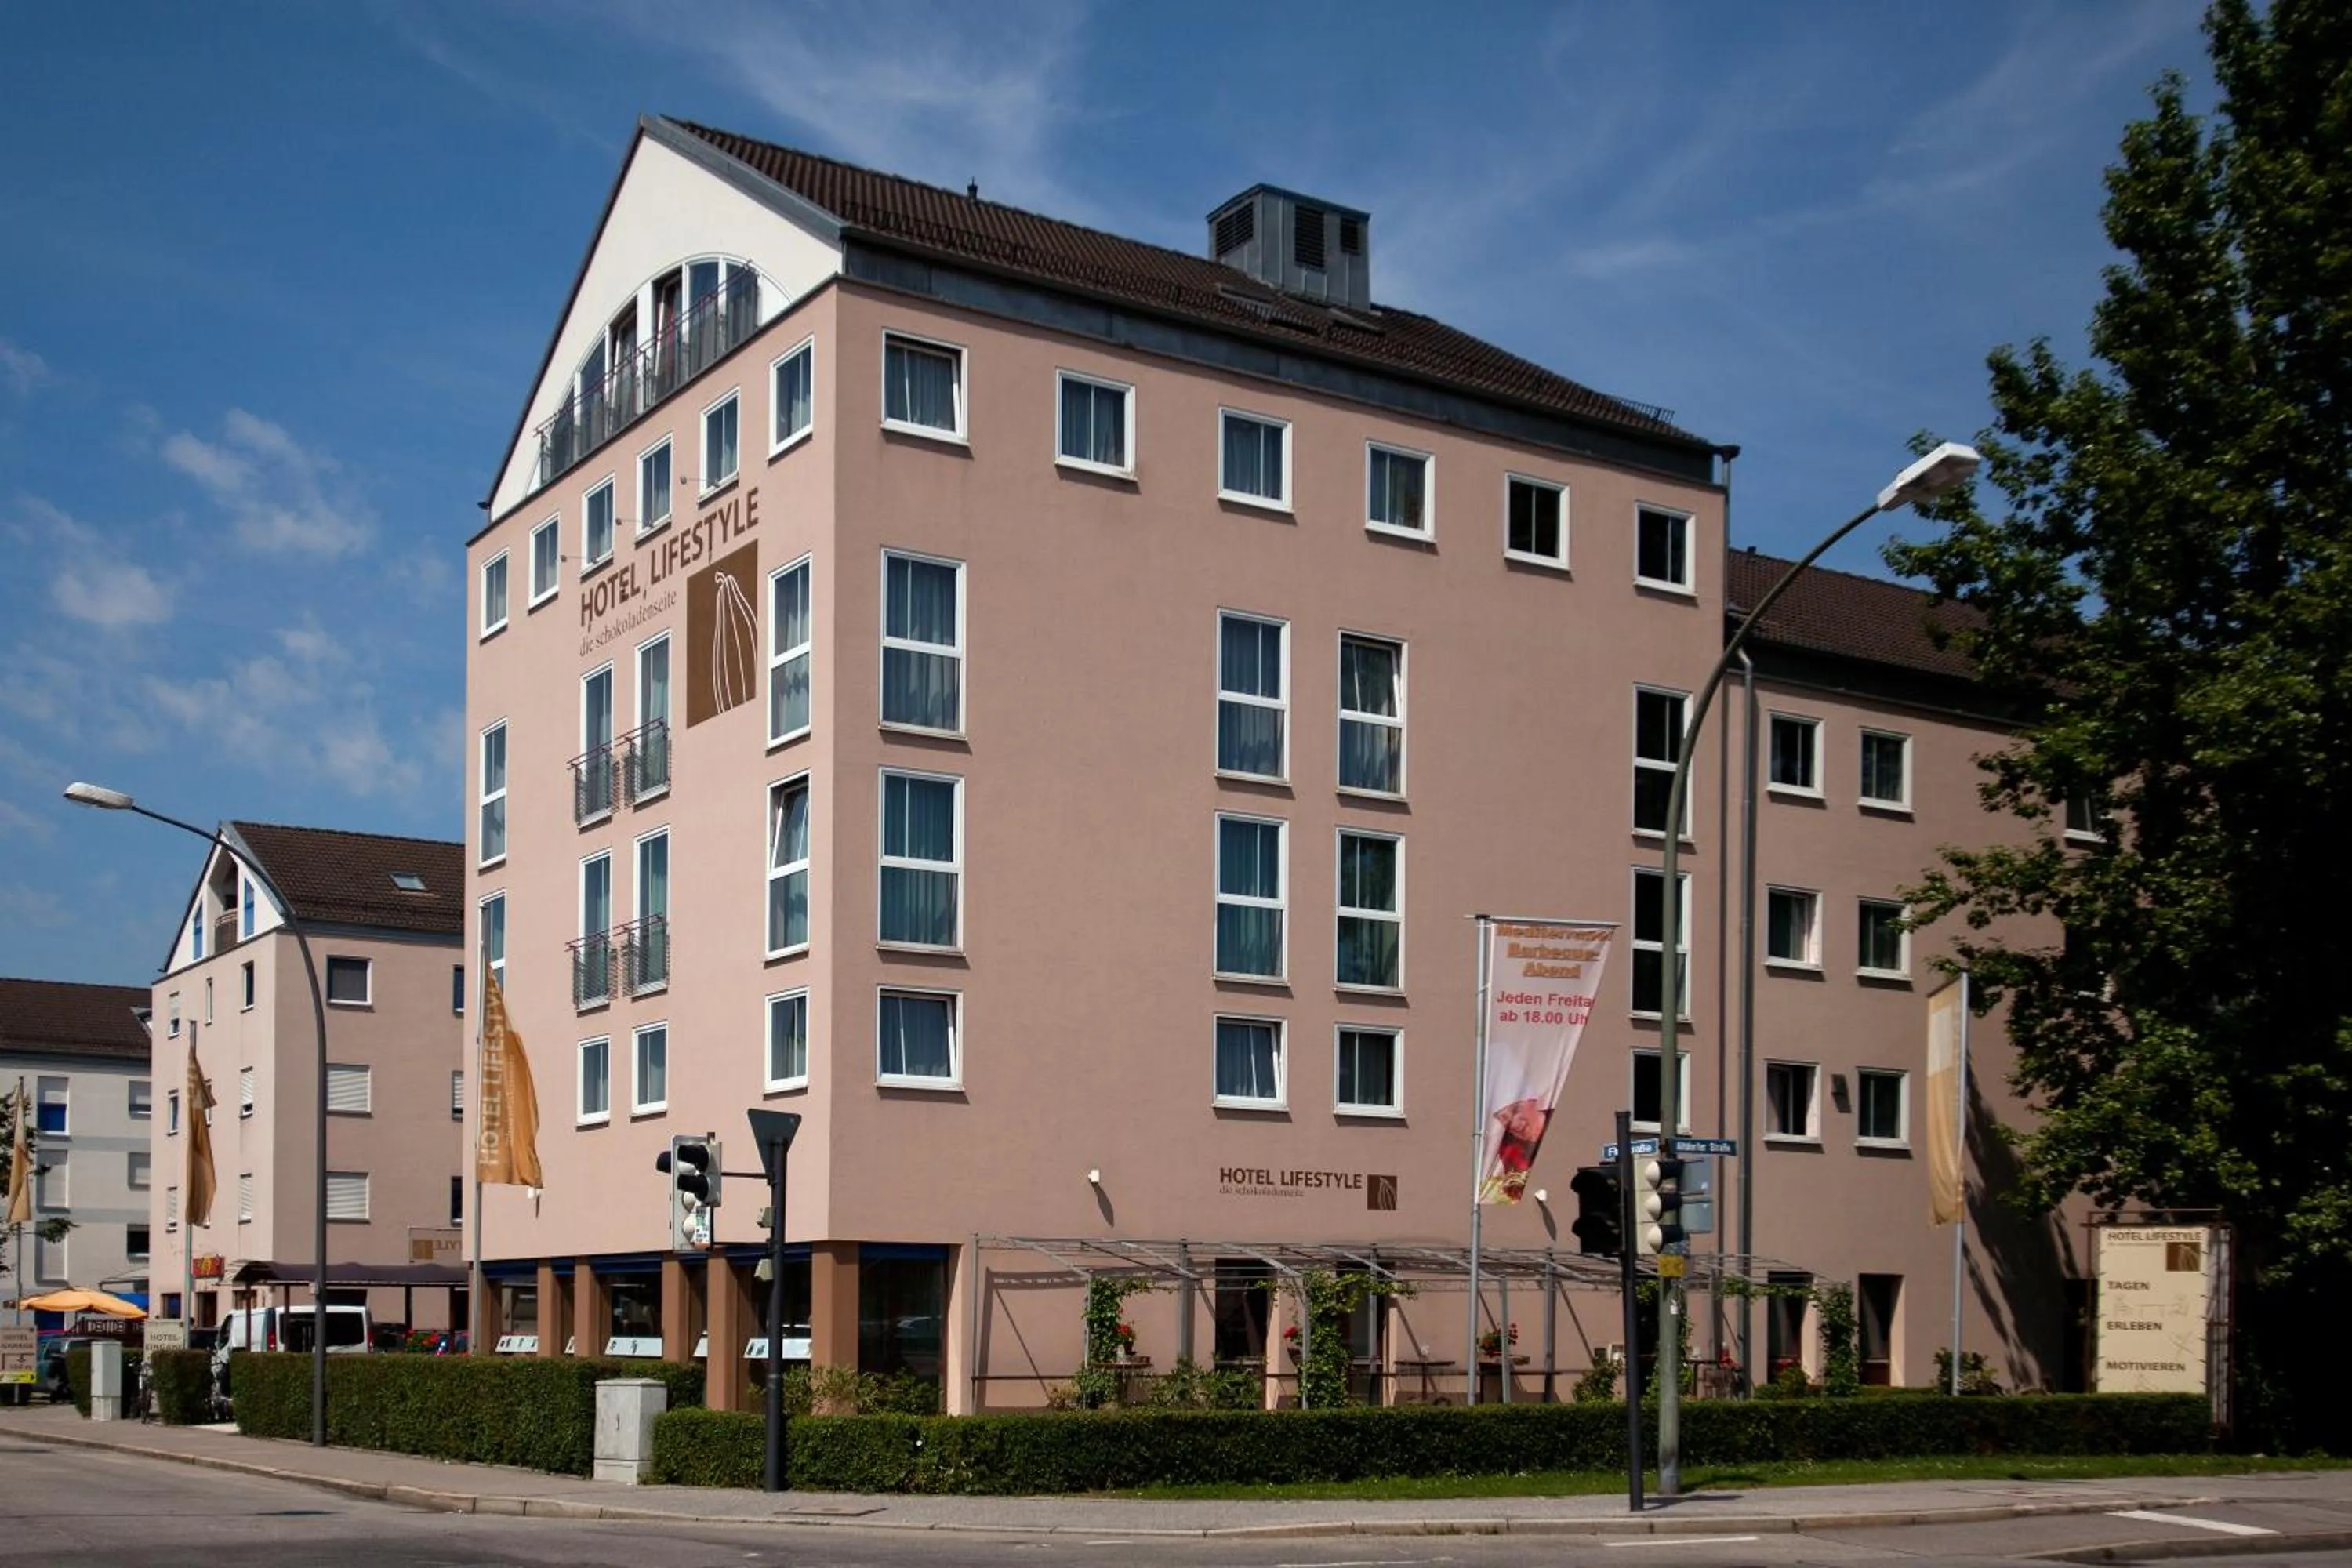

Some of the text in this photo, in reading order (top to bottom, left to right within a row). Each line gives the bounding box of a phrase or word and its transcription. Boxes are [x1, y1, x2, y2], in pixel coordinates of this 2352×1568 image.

[581, 488, 759, 627] HOTEL LIFESTYLE
[579, 590, 677, 656] die schokoladenseite
[1497, 991, 1595, 1008] Jeden Freita
[1499, 1010, 1588, 1025] ab 18.00 Uh
[479, 1091, 502, 1166] HOTEL
[1710, 1142, 1731, 1152] Straße
[1219, 1167, 1363, 1189] HOTEL LIFESTYLE
[2107, 1232, 2202, 1241] HOTEL LIFESTYLE
[2107, 1280, 2150, 1290] TAGEN
[2107, 1321, 2163, 1330] ERLEBEN
[2106, 1362, 2186, 1371] MOTIVIEREN
